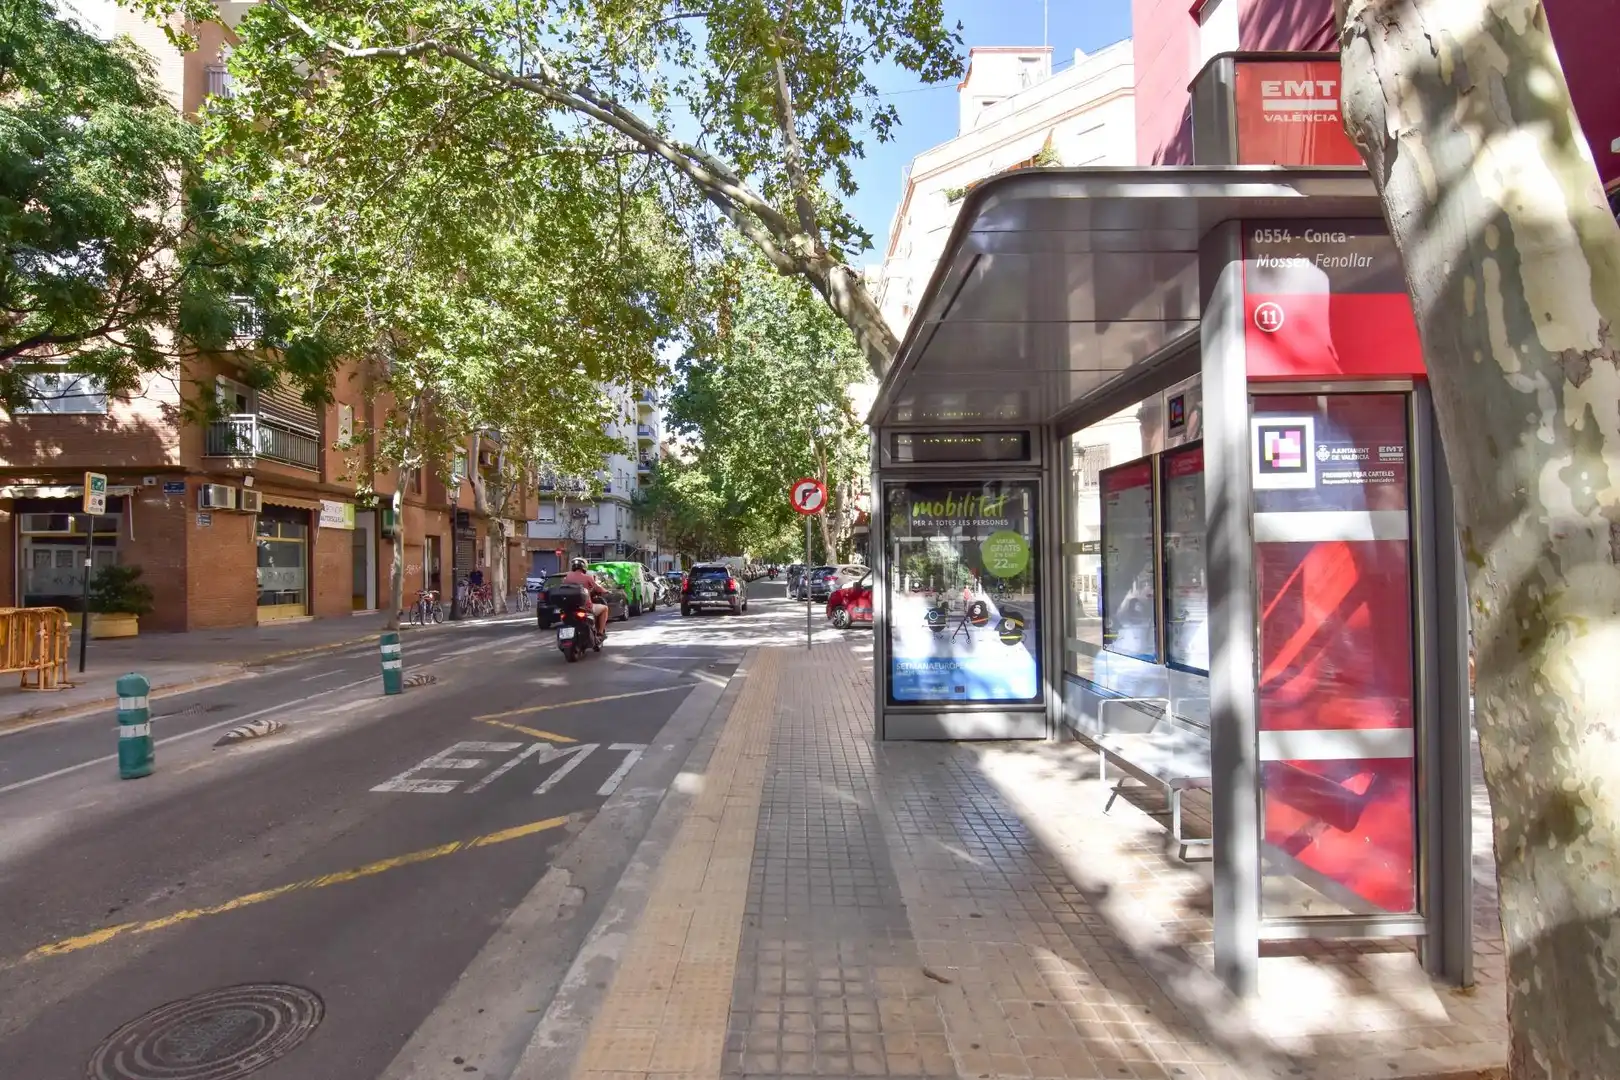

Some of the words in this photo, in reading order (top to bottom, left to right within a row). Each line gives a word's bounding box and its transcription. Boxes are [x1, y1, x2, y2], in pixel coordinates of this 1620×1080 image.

[1261, 80, 1336, 96] EMT
[1254, 229, 1291, 243] 0554
[1304, 229, 1346, 243] Conca
[1256, 253, 1310, 268] Mossén
[1315, 253, 1373, 268] Fenollar
[1261, 310, 1278, 324] 11
[912, 490, 1009, 517] mobilitat
[912, 519, 926, 527] PER
[936, 519, 957, 527] TOTES
[973, 518, 1009, 526] PERSONES
[990, 544, 1021, 552] GRATIS
[993, 558, 1008, 569] 22
[369, 741, 648, 796] EMT
